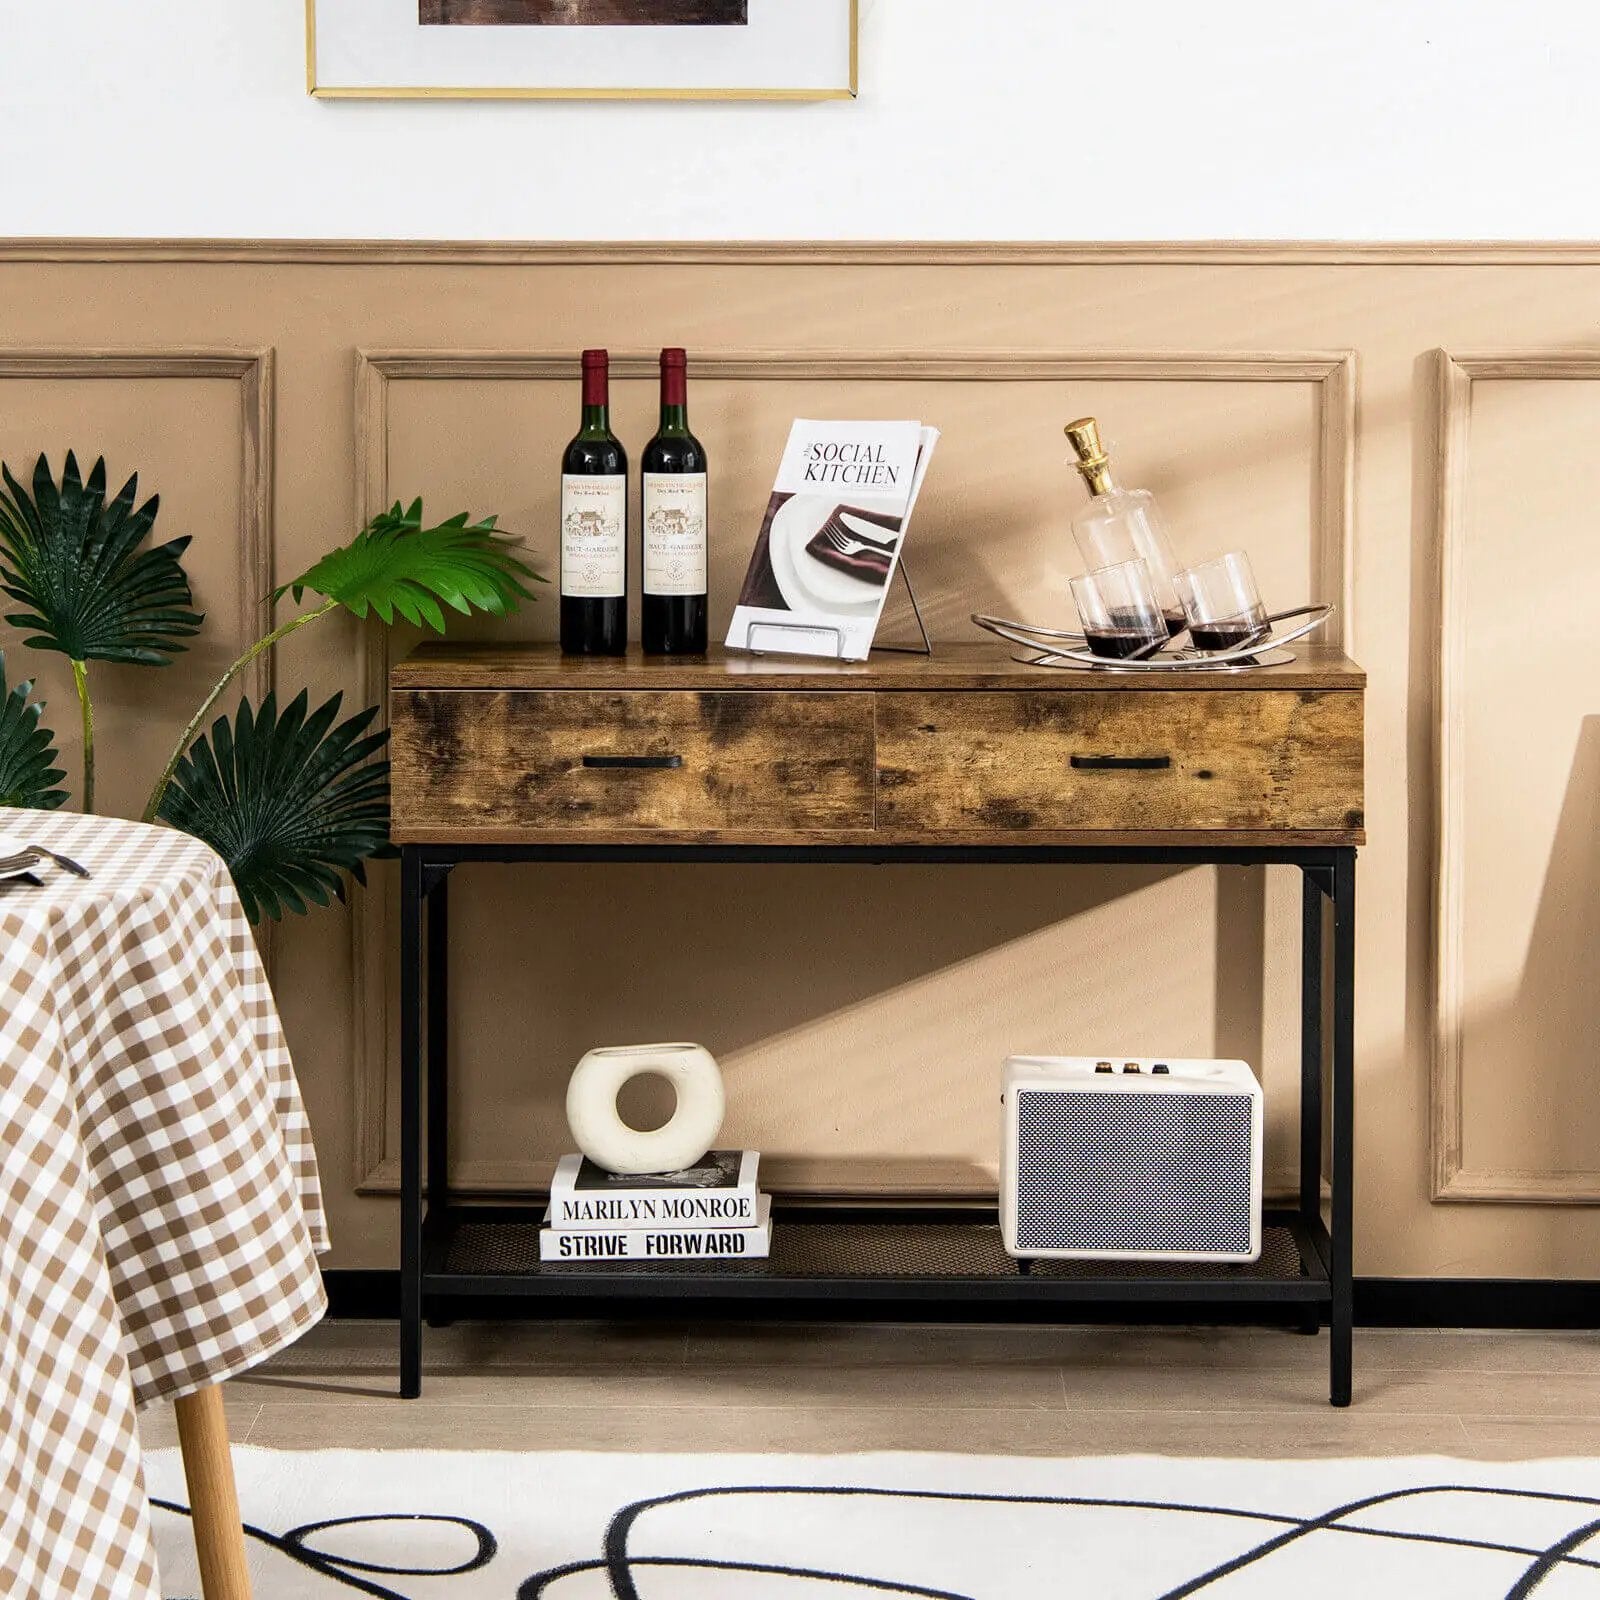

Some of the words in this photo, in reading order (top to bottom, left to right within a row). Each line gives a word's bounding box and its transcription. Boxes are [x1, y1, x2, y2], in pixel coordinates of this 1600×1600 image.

[811, 443, 886, 463] SOCIAL
[804, 463, 900, 484] KITCHEN
[562, 1199, 656, 1221] MARILYN
[662, 1198, 751, 1218] MONROE
[559, 1235, 628, 1257] STRIVE
[645, 1233, 746, 1255] FORWARD
